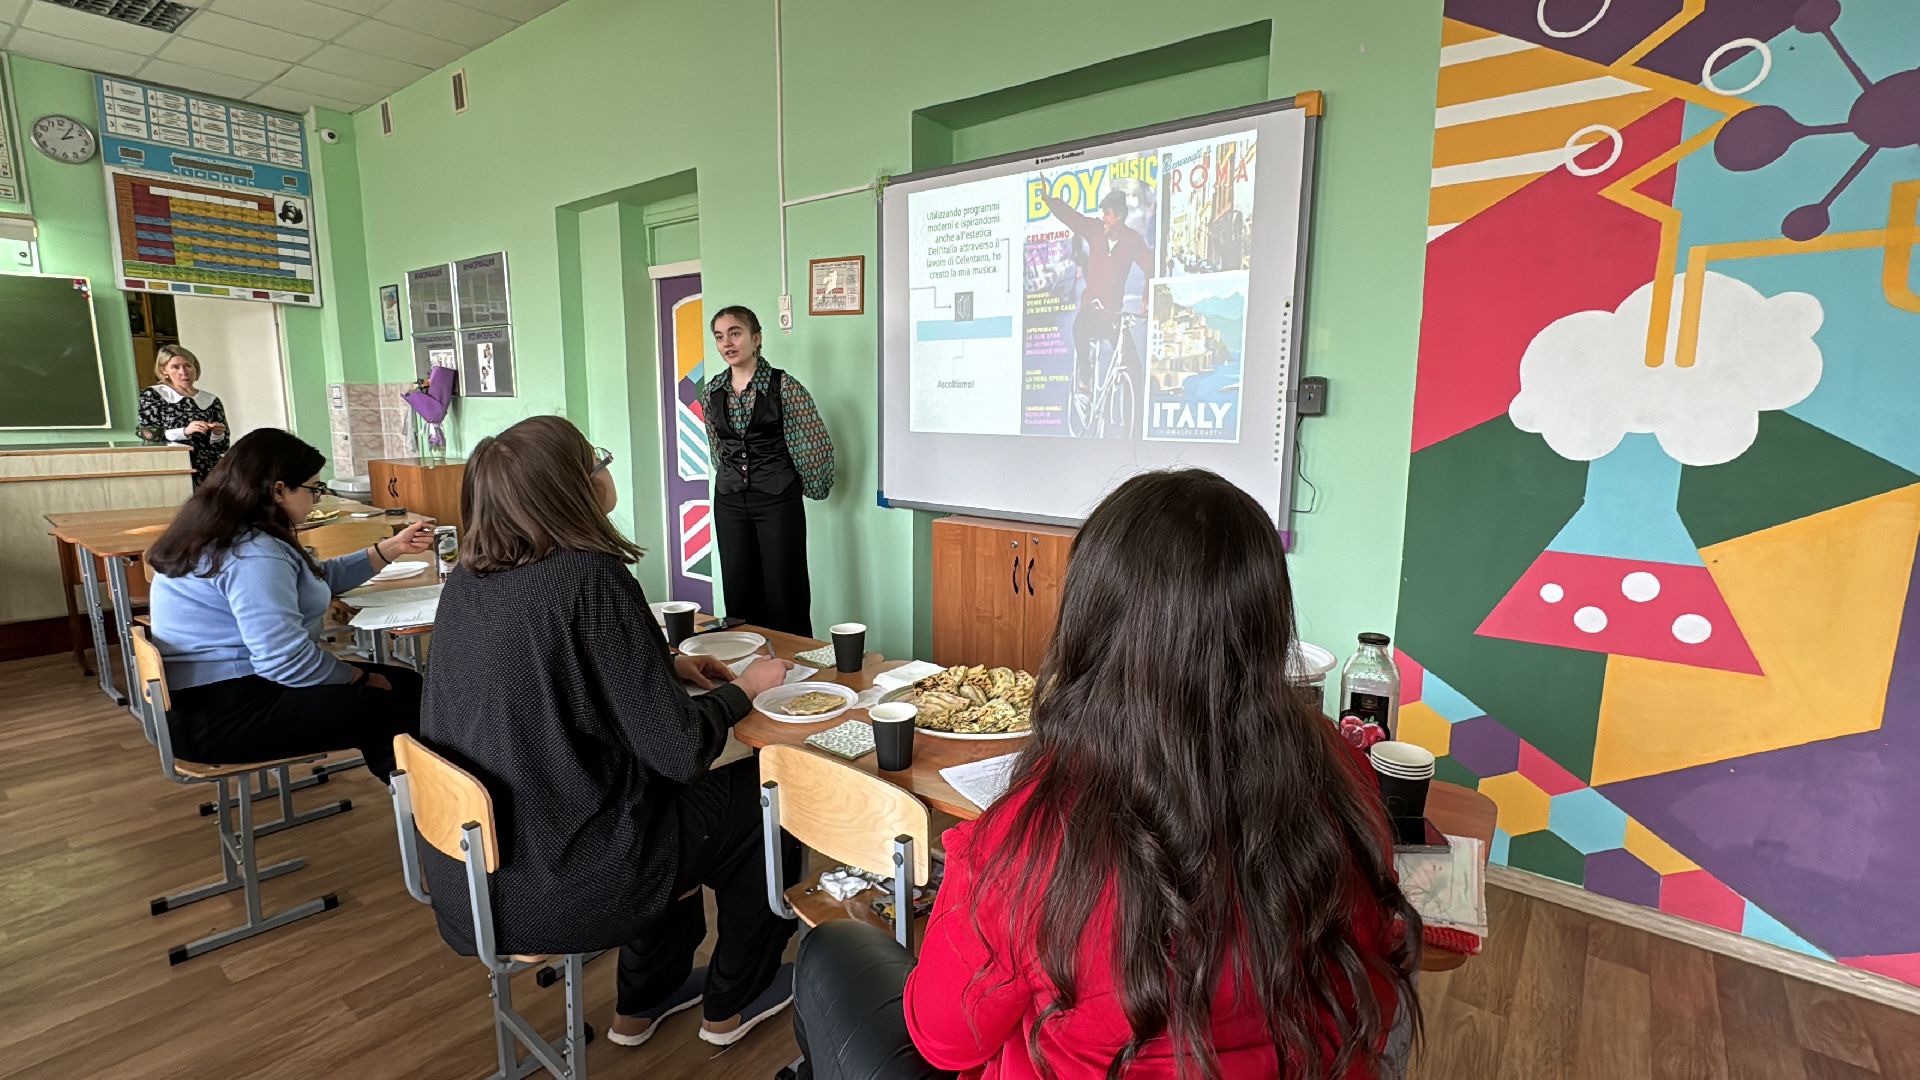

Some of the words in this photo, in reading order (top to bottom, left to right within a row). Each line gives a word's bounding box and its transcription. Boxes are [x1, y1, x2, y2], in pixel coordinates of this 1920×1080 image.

[47, 119, 55, 128] 11
[57, 119, 65, 127] 12
[51, 147, 57, 155] 7
[1109, 155, 1158, 191] MUSIC
[1172, 157, 1249, 193] ROMA
[1026, 165, 1108, 223] BOY
[927, 207, 961, 221] Utilizzando
[963, 203, 1000, 217] programmi
[927, 220, 954, 232] moderni
[961, 215, 1000, 229] ispirandomi
[935, 233, 954, 244] anche
[1026, 230, 1070, 244] CELENTANO
[959, 241, 994, 253] attraverso
[948, 256, 954, 266] di
[955, 254, 991, 265] Celentano,
[992, 252, 1001, 261] ho
[929, 269, 949, 279] creato
[951, 268, 957, 277] la
[958, 268, 970, 277] mia
[972, 265, 999, 275] musica.
[937, 379, 975, 389] Ascoltiamo!
[1153, 402, 1232, 429] ITALY
